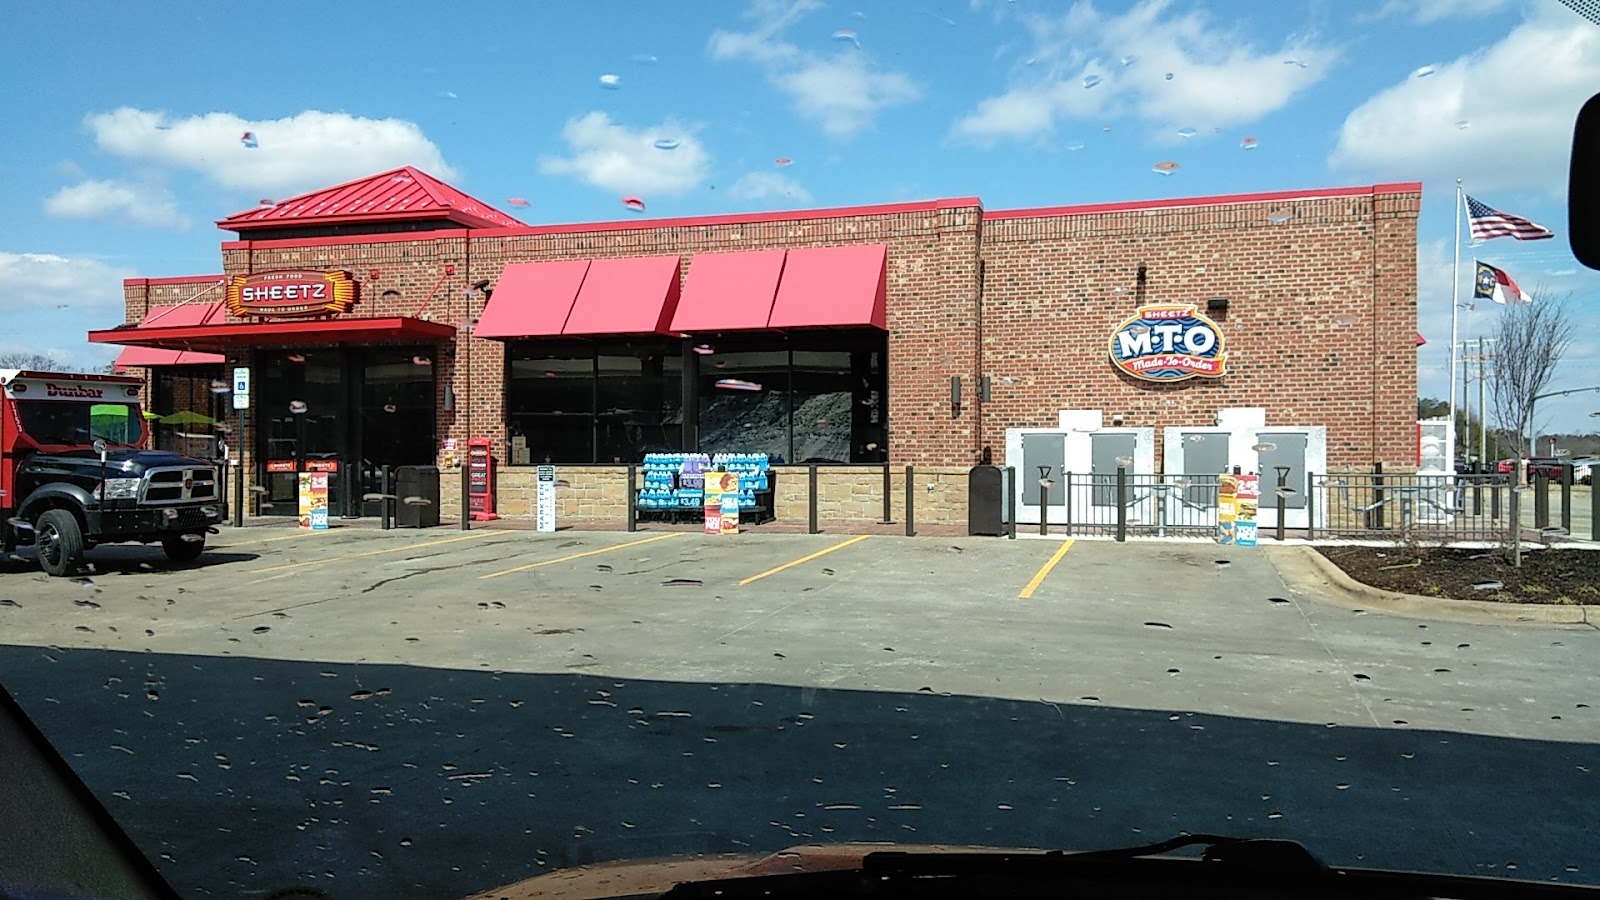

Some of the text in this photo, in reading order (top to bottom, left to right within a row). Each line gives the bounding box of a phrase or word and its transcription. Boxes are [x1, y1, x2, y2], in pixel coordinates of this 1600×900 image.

[242, 284, 326, 300] SHEETZ
[1144, 309, 1191, 319] SHEETZ
[45, 383, 104, 398] Dunbar
[680, 498, 701, 506] $3.49
